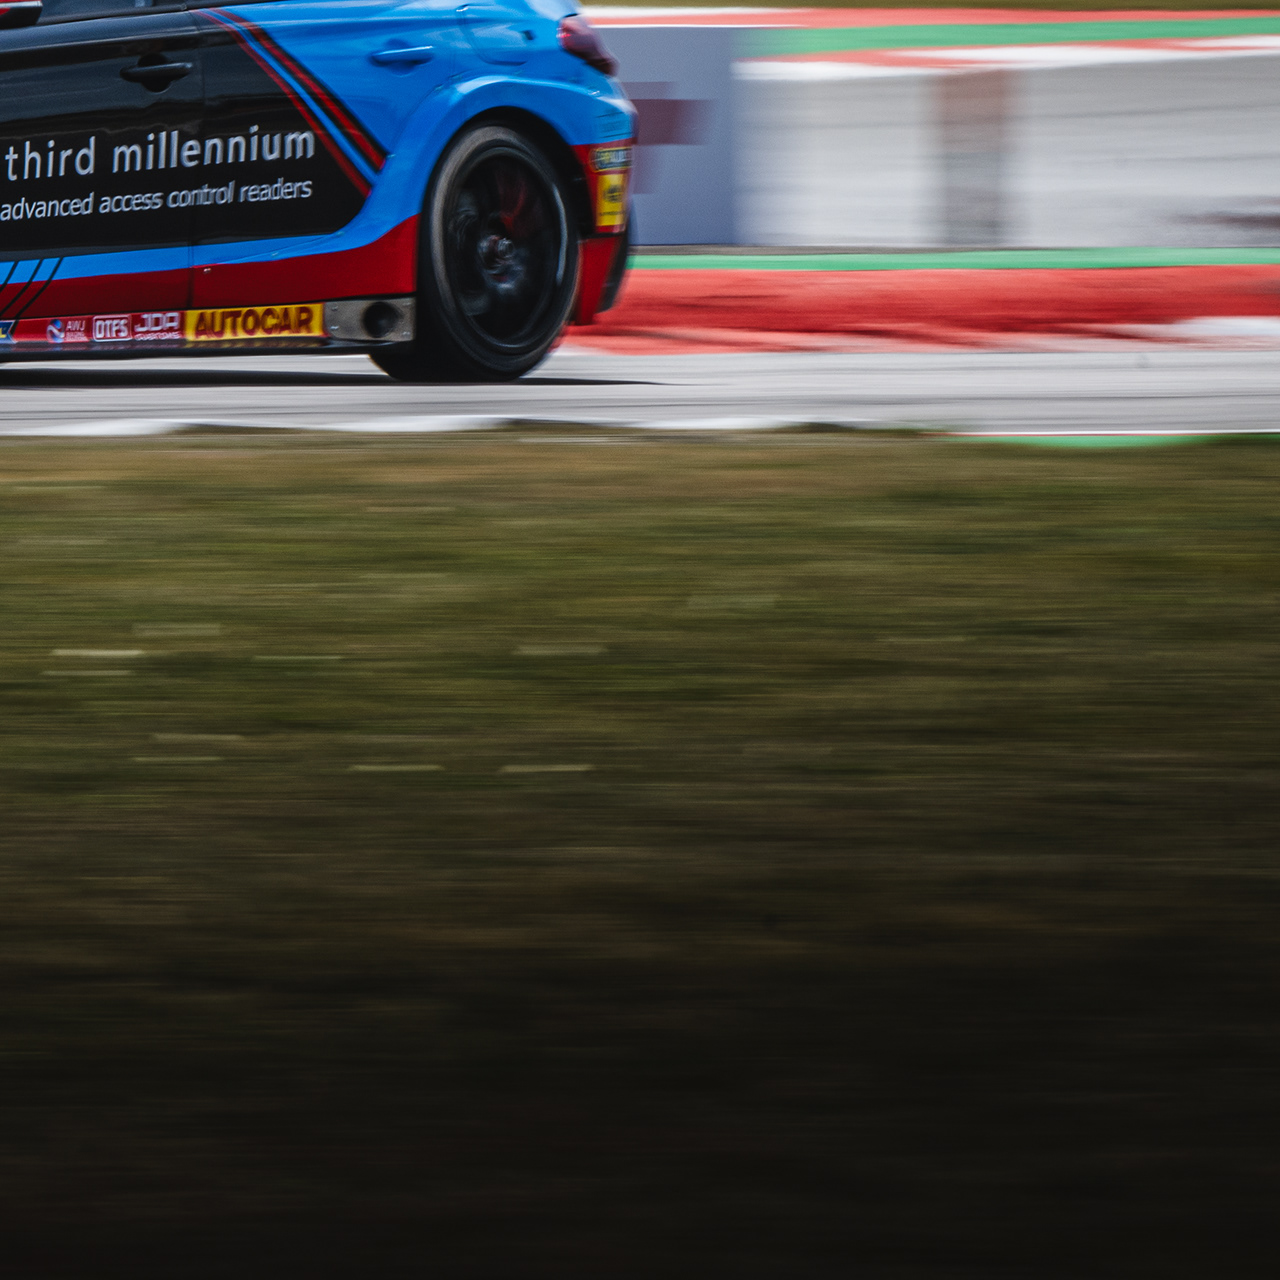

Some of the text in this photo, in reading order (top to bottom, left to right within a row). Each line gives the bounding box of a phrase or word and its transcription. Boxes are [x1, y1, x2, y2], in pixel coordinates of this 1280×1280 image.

[5, 125, 316, 182] third millennium
[0, 177, 313, 221] advanced access control readers
[134, 312, 179, 332] JDA
[195, 306, 314, 337] AUTOCAR
